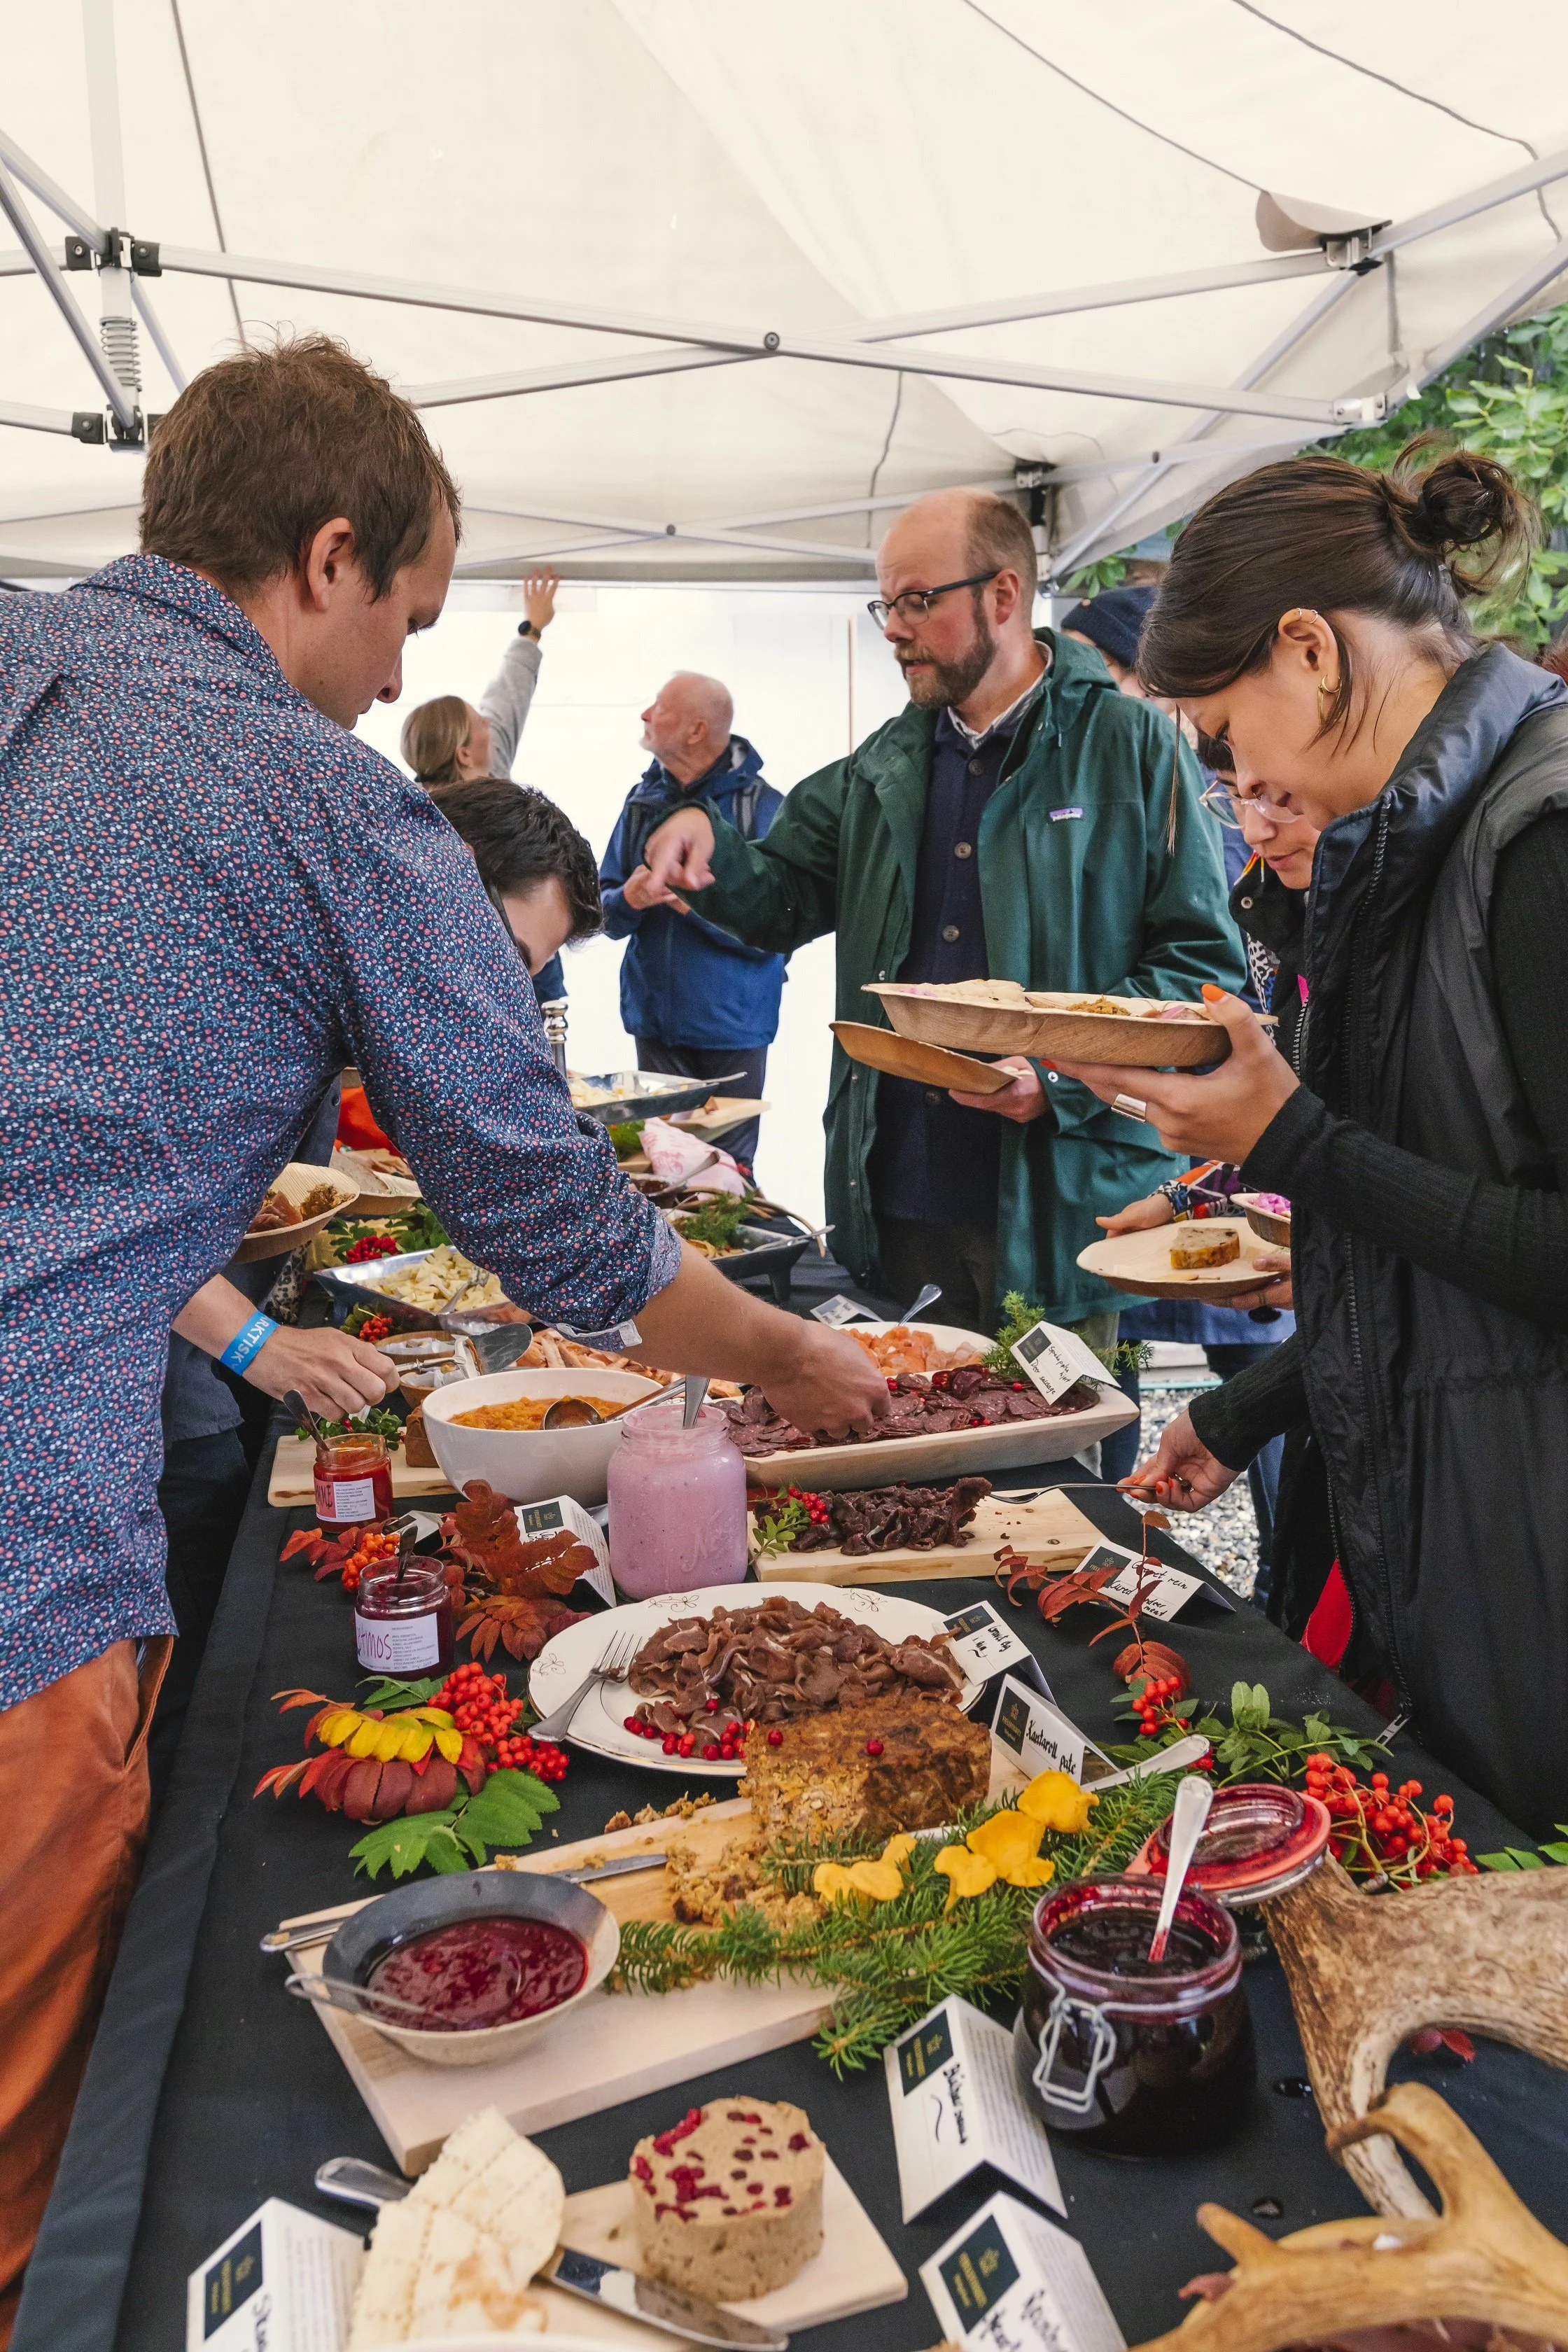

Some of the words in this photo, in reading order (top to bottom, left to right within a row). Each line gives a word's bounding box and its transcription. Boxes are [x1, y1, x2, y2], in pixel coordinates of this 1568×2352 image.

[1030, 1358, 1040, 1373] Deer
[1039, 1376, 1056, 1395] sausage
[1168, 1578, 1188, 1590] rein
